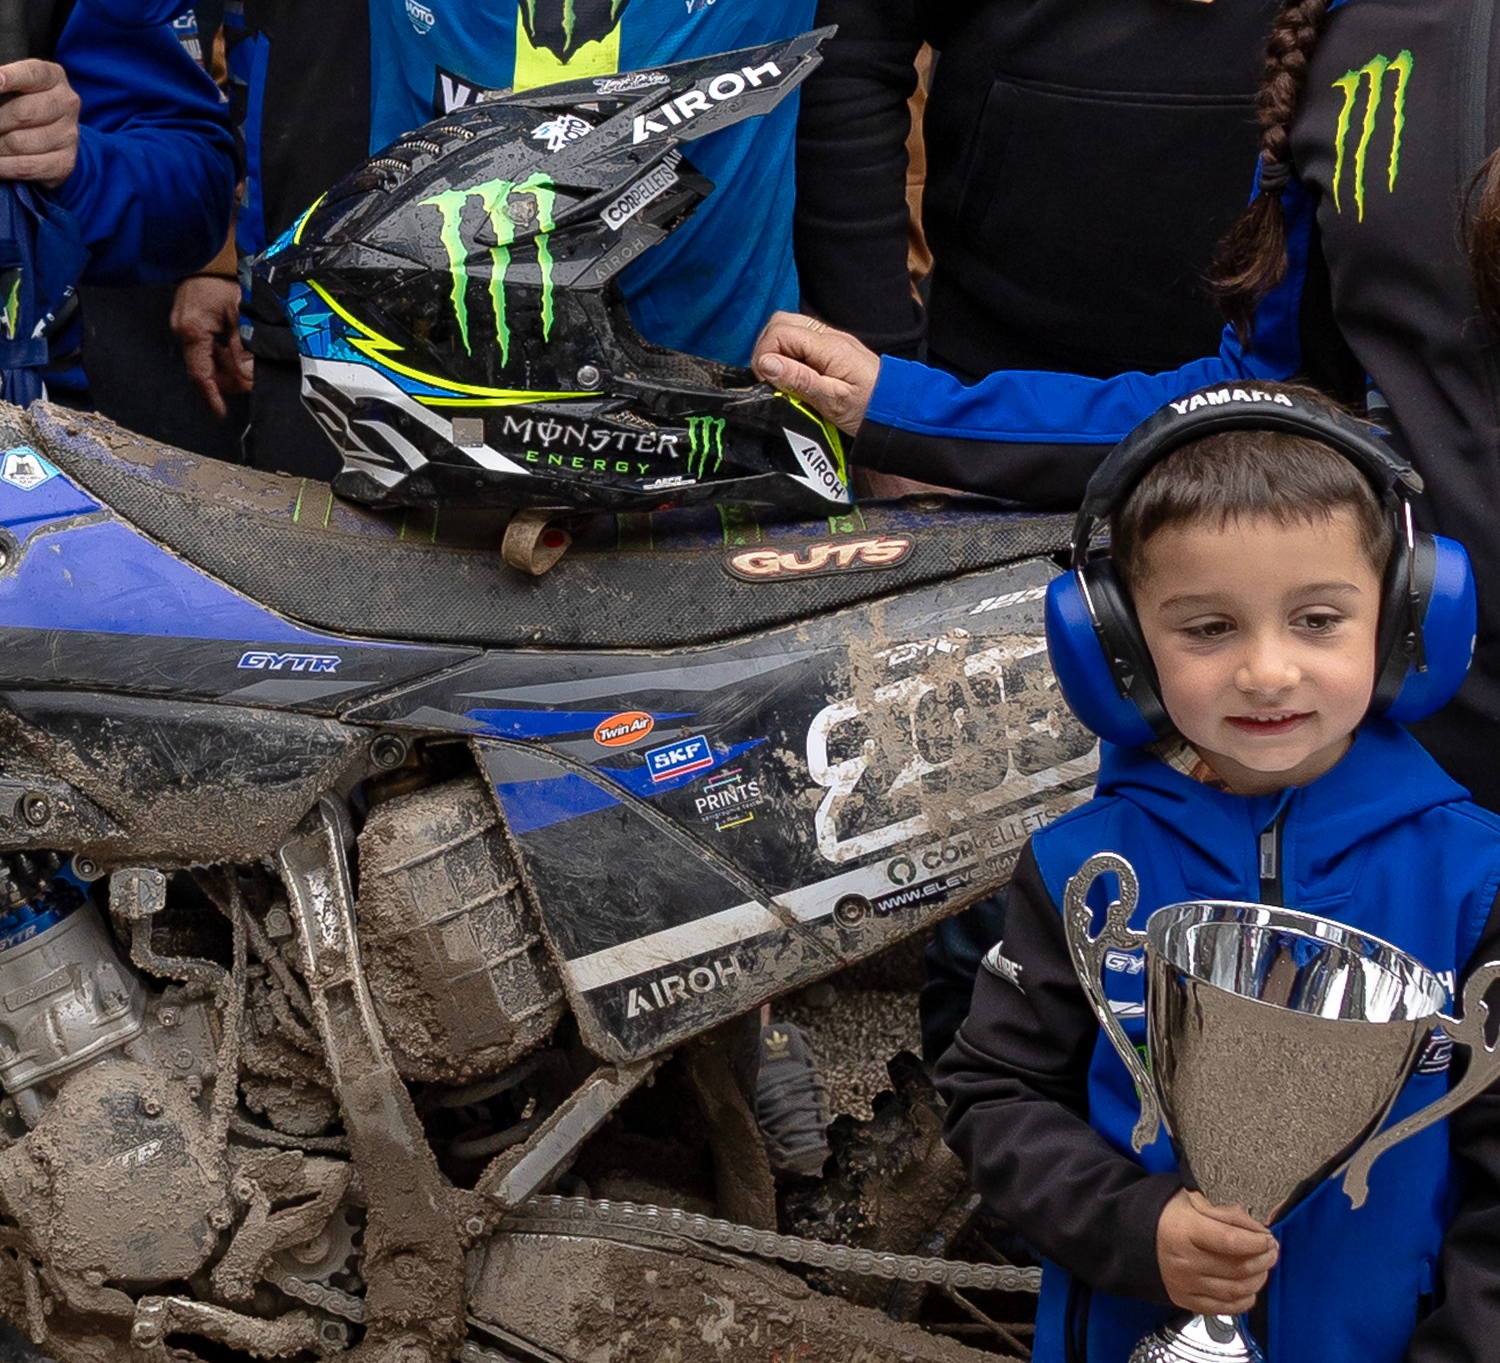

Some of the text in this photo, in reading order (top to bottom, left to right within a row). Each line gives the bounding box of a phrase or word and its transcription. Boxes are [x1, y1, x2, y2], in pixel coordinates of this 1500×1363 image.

[632, 60, 782, 144] AIROH
[607, 167, 675, 222] CORPELLETS
[594, 238, 645, 281] AIROH
[1169, 388, 1293, 415] YAMAHA
[502, 415, 680, 458] MONSTER
[526, 450, 651, 475] ENERGY
[802, 445, 846, 500] AIROH
[731, 536, 910, 575] GUTS
[237, 651, 342, 674] GYTR
[600, 716, 650, 742] Twin Air
[654, 742, 702, 770] SKF
[694, 781, 761, 814] PRINTS
[627, 955, 746, 1019] AIROH
